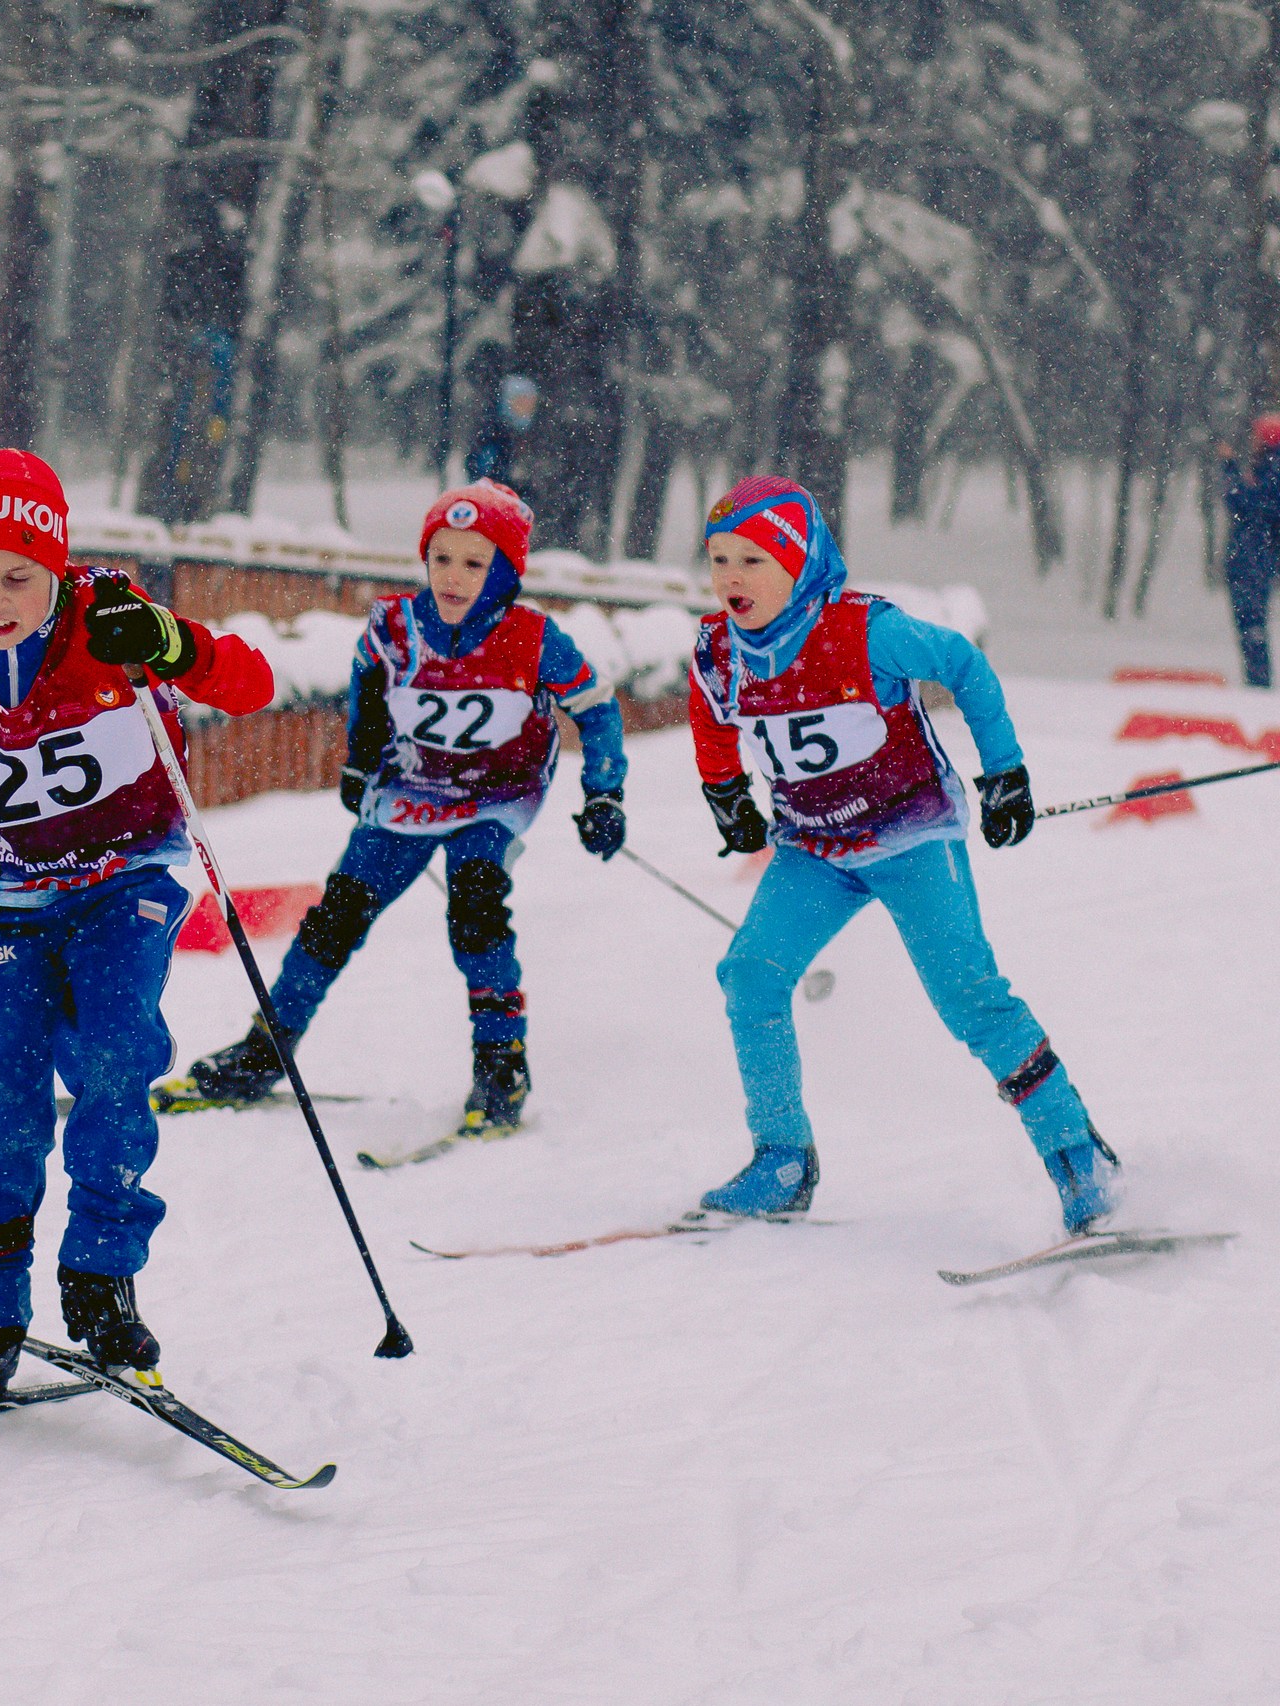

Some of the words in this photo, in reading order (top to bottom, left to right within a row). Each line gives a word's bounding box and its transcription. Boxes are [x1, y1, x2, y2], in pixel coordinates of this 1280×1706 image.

[762, 509, 807, 554] RUSSIA
[96, 603, 142, 616] SWIX
[413, 693, 494, 749] 22
[753, 713, 839, 776] 15
